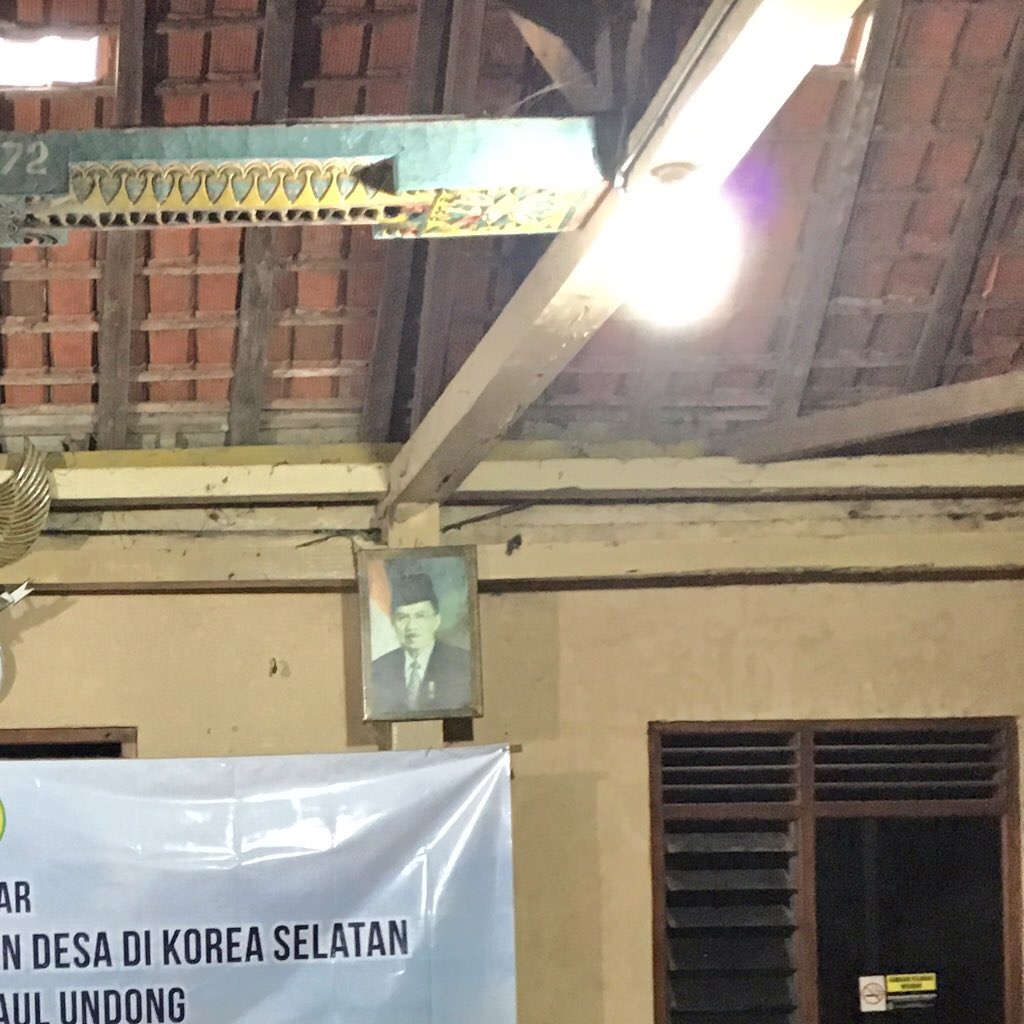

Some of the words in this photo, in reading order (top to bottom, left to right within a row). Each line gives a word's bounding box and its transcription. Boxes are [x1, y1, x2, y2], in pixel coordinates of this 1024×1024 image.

[33, 932, 111, 969] DESA
[123, 931, 151, 966] DI
[163, 927, 263, 965] KOREA
[274, 920, 407, 960] SELATAN
